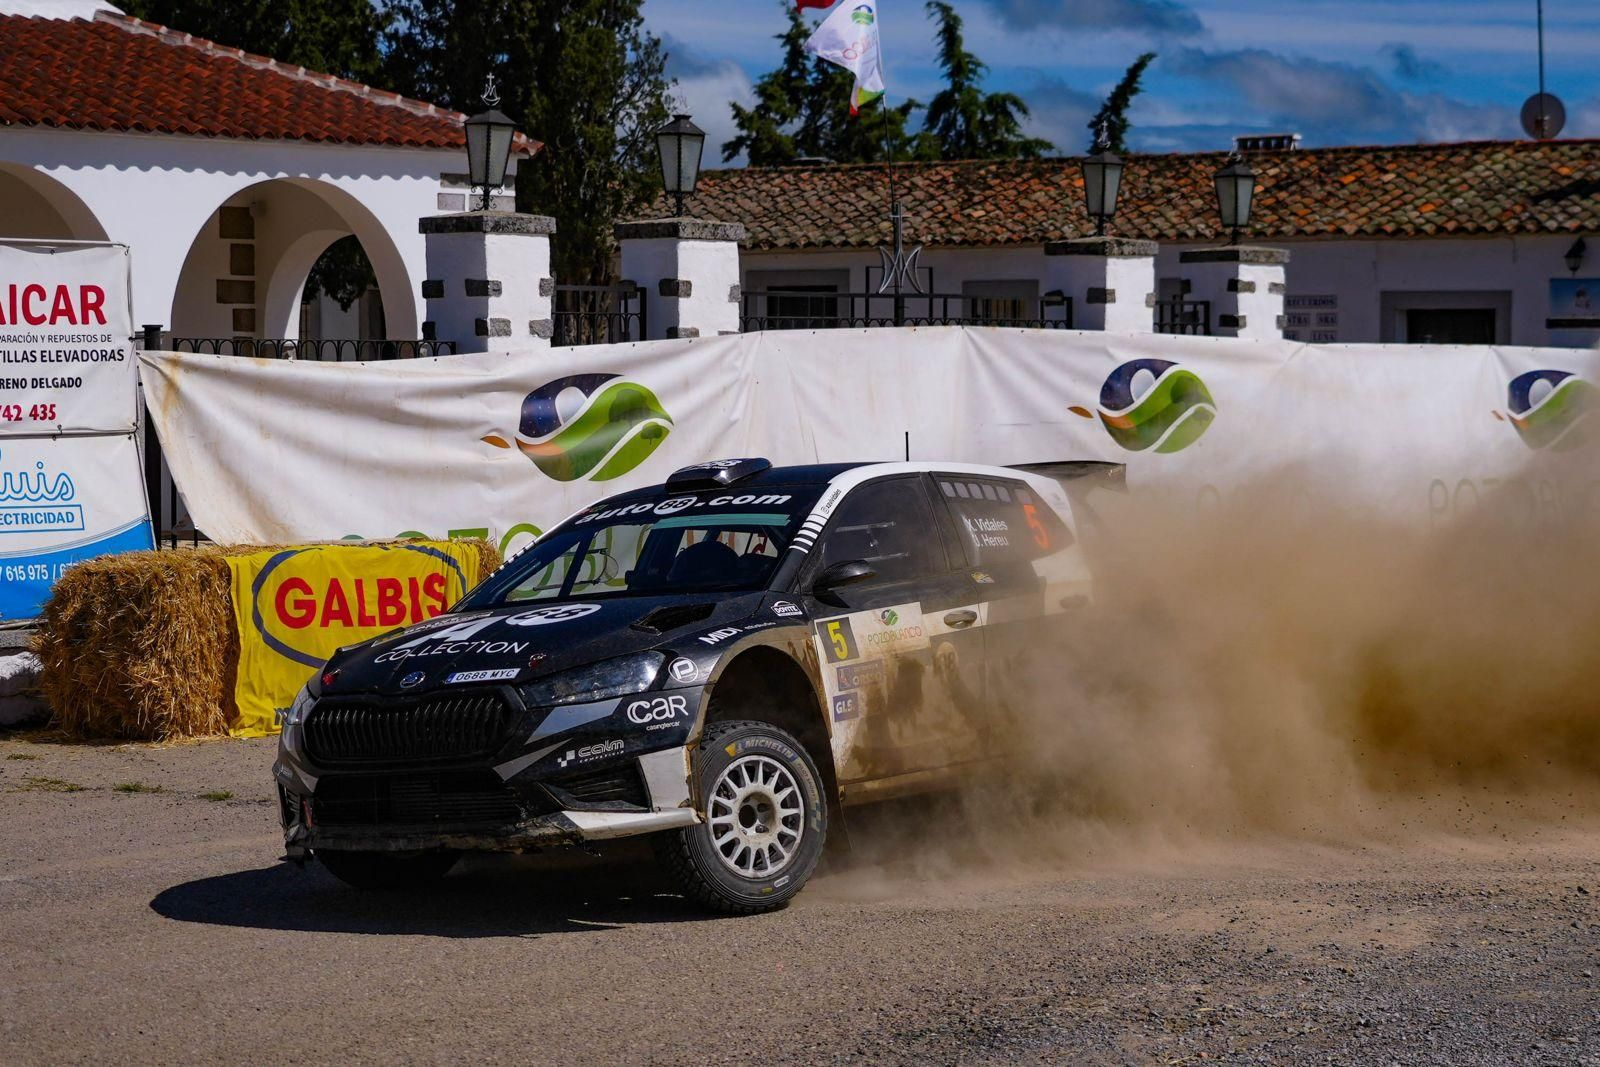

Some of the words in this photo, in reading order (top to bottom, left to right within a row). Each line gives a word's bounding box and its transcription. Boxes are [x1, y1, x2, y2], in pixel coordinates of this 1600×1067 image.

[40, 334, 45, 343] Y
[48, 334, 98, 343] REPUESTOS
[101, 334, 112, 343] DE
[41, 349, 125, 363] ELEVADORAS
[31, 377, 82, 389] DELGADO
[0, 404, 22, 421] 42
[29, 403, 56, 420] 435
[0, 460, 74, 501] uis
[974, 517, 1008, 532] Vidales
[1023, 504, 1049, 548] 5
[6, 565, 26, 582] 615
[27, 564, 49, 581] 975
[275, 572, 449, 630] GALBIS
[698, 626, 743, 645] MIDI
[826, 621, 849, 660] 5
[374, 641, 530, 664] COLLECTION
[456, 671, 488, 681] 0688
[490, 669, 515, 679] MYC
[745, 738, 795, 759] MICHELIN
